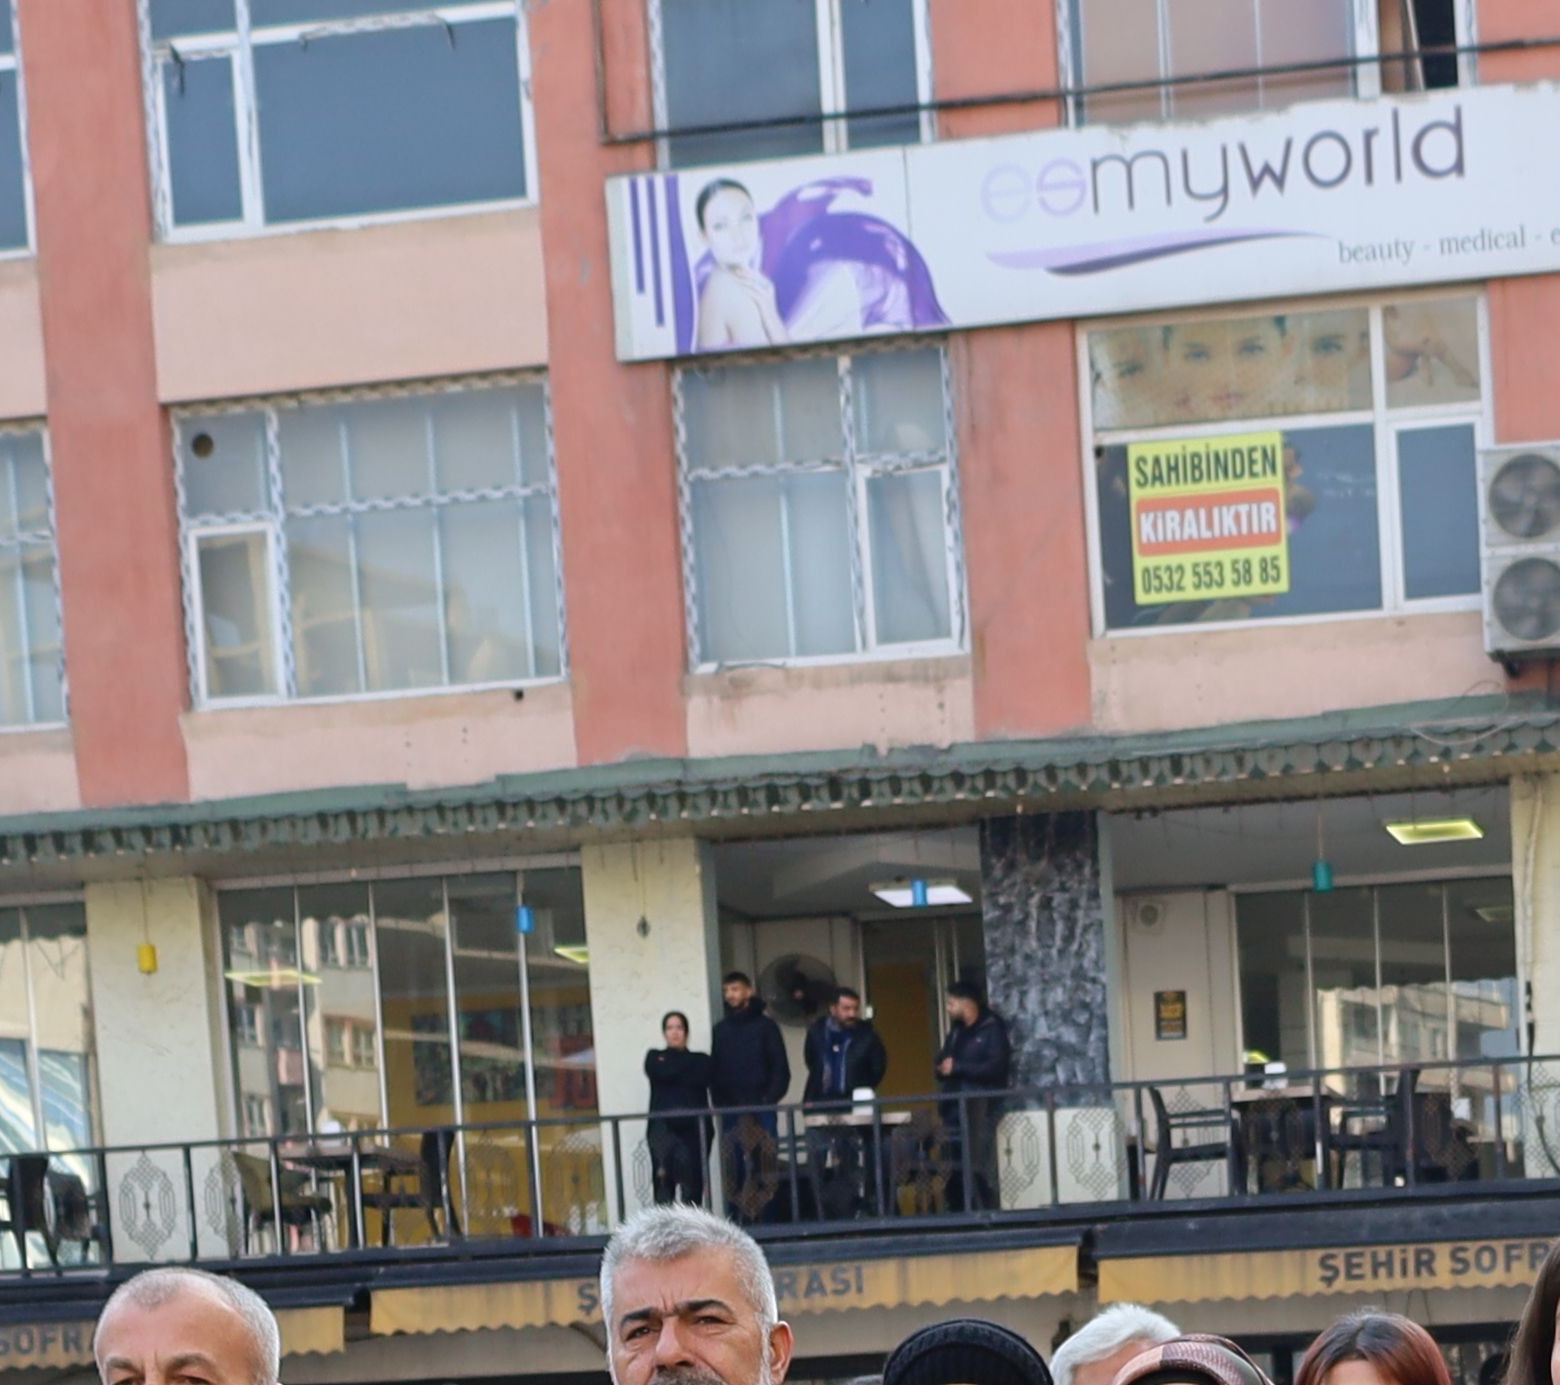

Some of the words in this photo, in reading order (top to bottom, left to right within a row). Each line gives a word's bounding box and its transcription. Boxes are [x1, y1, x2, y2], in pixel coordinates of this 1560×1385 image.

[1339, 239, 1414, 267] beauty
[1440, 224, 1526, 256] medical
[1134, 443, 1278, 489] SAHİBİNDEN
[1142, 563, 1186, 595] 0532
[1192, 560, 1225, 591] 553
[1231, 558, 1253, 588] 58
[1259, 555, 1282, 584] 85
[1450, 1242, 1551, 1275] SOFR
[775, 1265, 864, 1299] RASI
